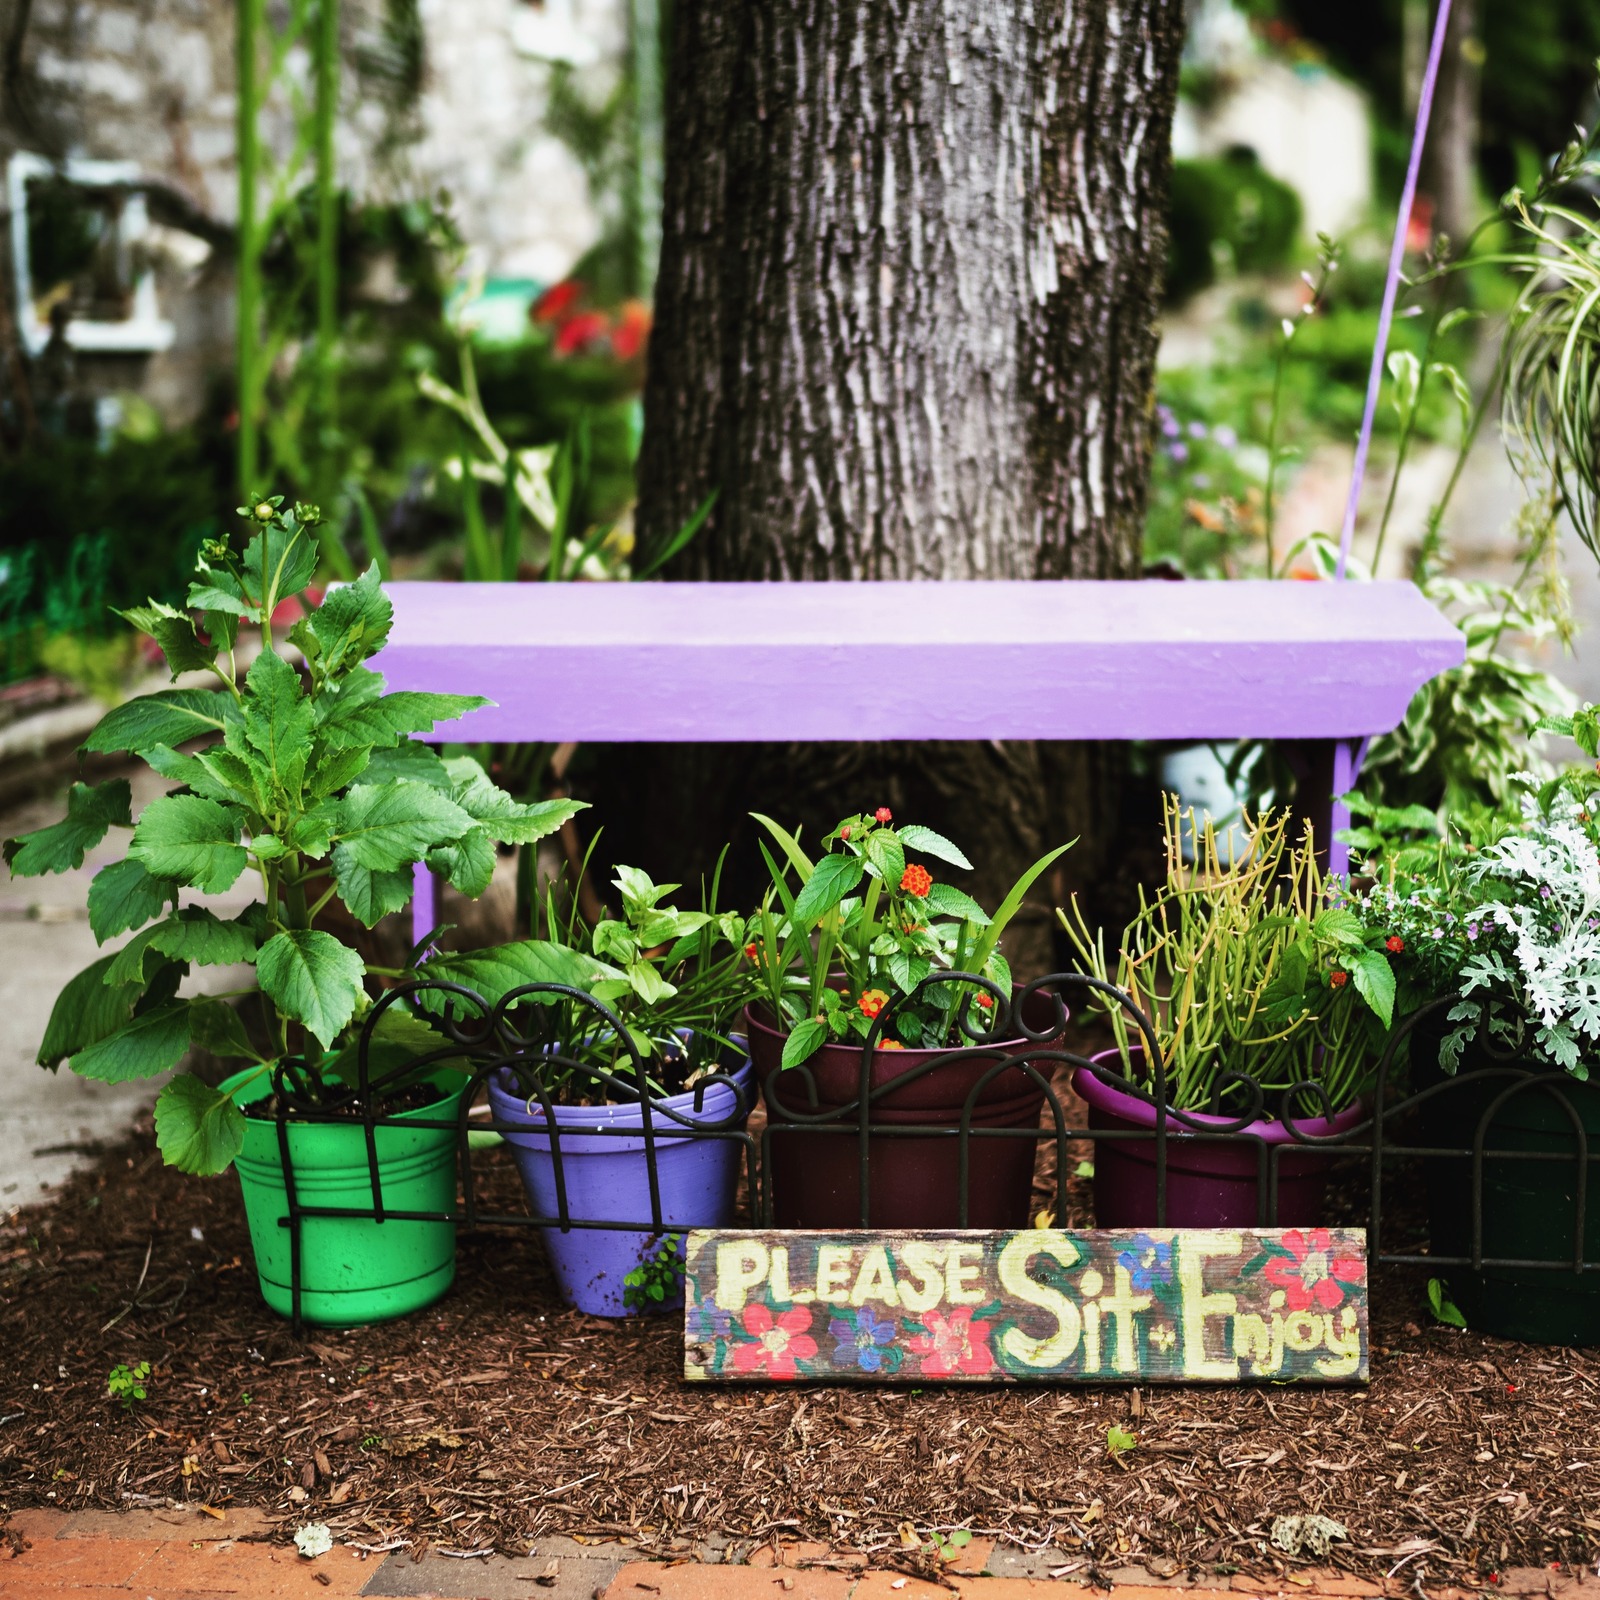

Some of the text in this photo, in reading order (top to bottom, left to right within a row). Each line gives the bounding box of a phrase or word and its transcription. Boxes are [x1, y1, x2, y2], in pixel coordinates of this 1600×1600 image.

[716, 1239, 986, 1312] PLEASE
[998, 1229, 1151, 1373] Sit
[1177, 1231, 1361, 1379] Enjoy
